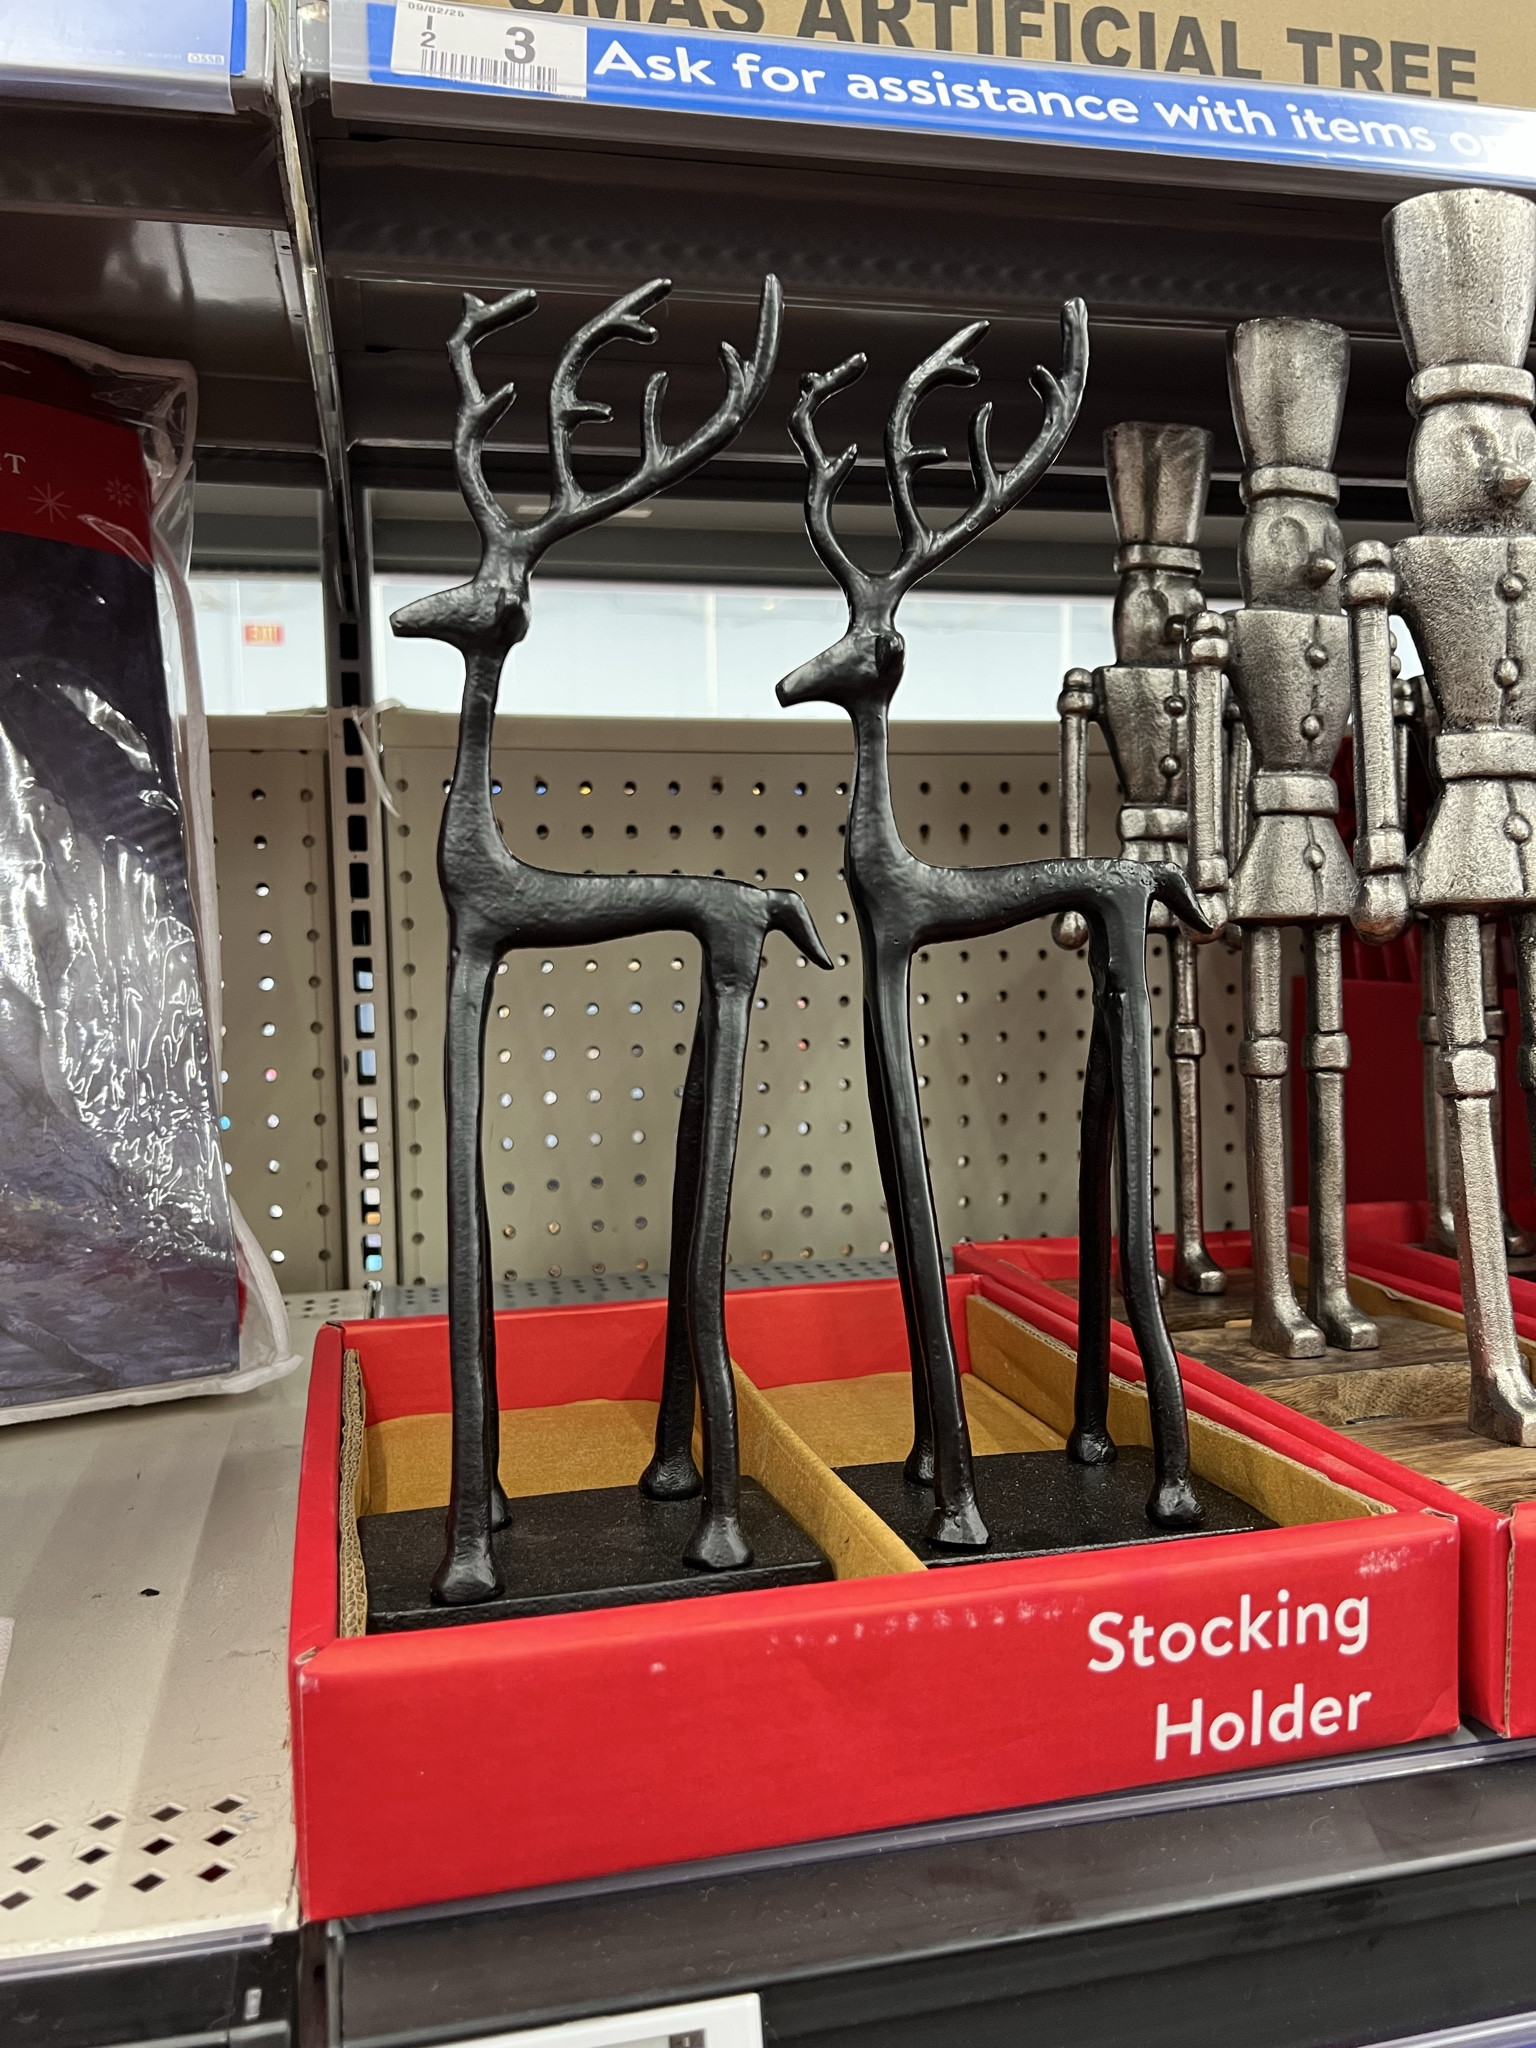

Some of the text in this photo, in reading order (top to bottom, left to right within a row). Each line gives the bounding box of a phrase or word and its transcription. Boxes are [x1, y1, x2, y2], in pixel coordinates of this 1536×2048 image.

[420, 31, 437, 48] 2
[504, 26, 536, 64] 3
[508, 0, 1479, 102] AS ARTIFICIAL TREE
[594, 40, 1488, 158] Ask for assistance with items o
[0, 453, 27, 474] T
[1088, 1589, 1369, 1672] Stocking
[1155, 1683, 1372, 1760] Holder
